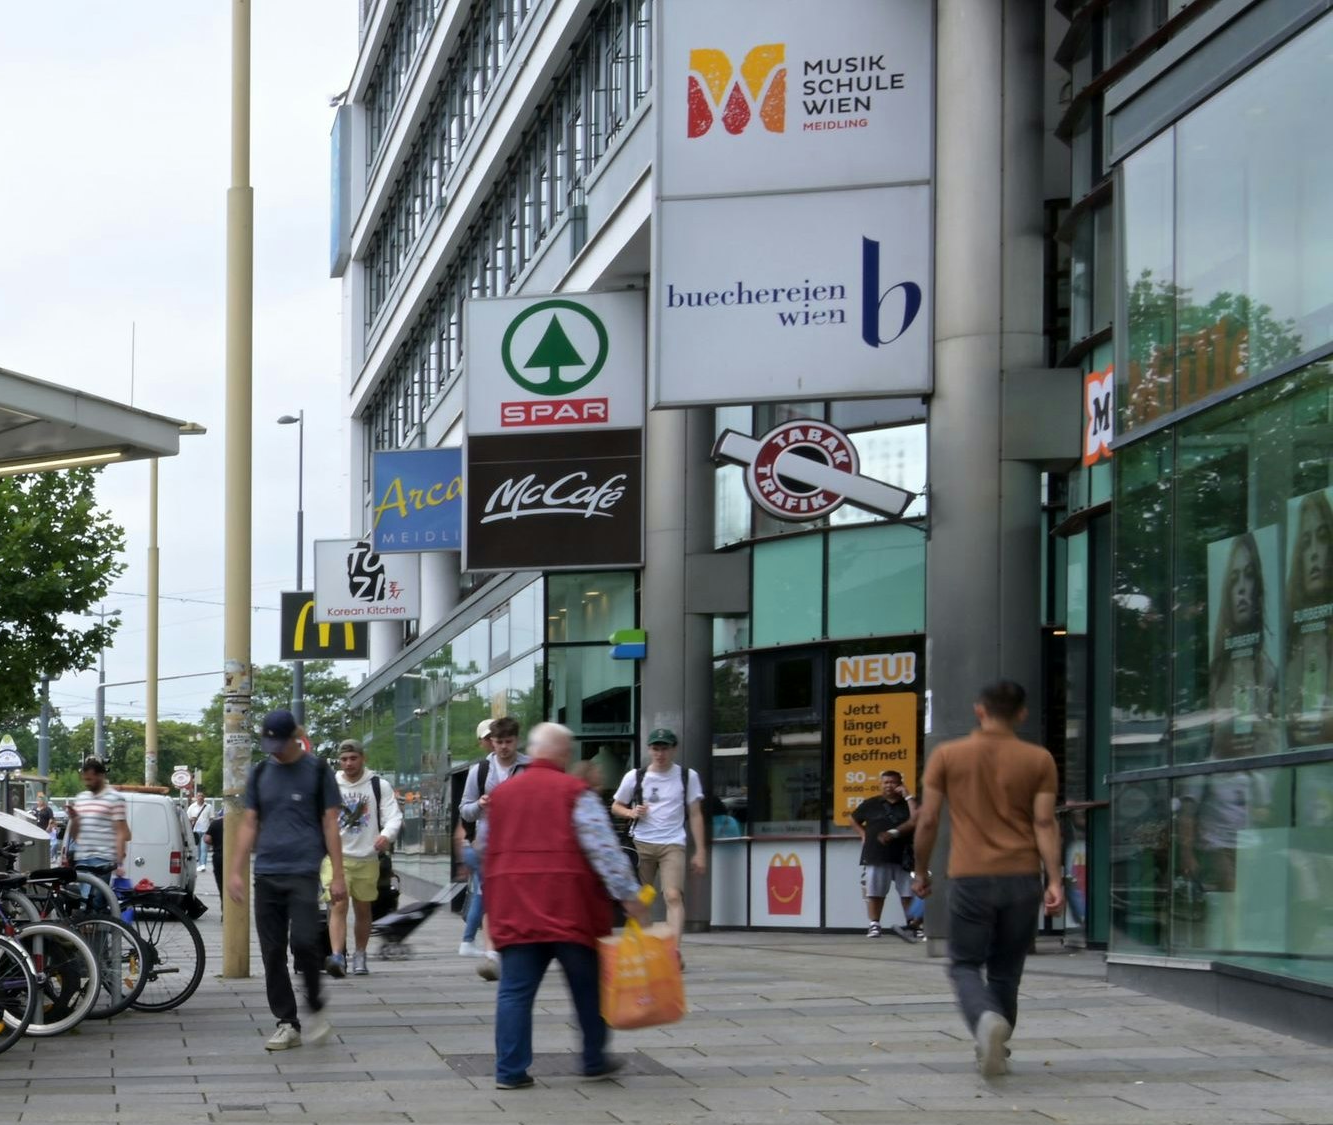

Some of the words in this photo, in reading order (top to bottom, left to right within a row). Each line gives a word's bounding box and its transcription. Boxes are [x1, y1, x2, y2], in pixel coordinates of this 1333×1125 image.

[803, 54, 886, 76] MUSIK
[803, 73, 905, 96] SCHULE
[802, 97, 871, 116] WIEN
[803, 119, 868, 131] MEIDLING
[666, 279, 846, 308] buechereien
[777, 303, 846, 326] wien
[502, 401, 606, 425] SPAR
[772, 428, 849, 465] TABAK
[481, 471, 627, 524] McCafé
[757, 464, 828, 511] TRAFIK
[374, 476, 462, 528] Arca
[383, 530, 460, 544] MEIDLI
[327, 606, 365, 617] Korean
[367, 605, 406, 616] Kitchen
[839, 655, 912, 684] NEU!
[843, 703, 880, 717] Jetzt
[843, 720, 888, 733] länger
[843, 735, 863, 747] für
[866, 733, 901, 746] euch
[843, 748, 907, 765] geöffnet!
[845, 771, 866, 784] SO
